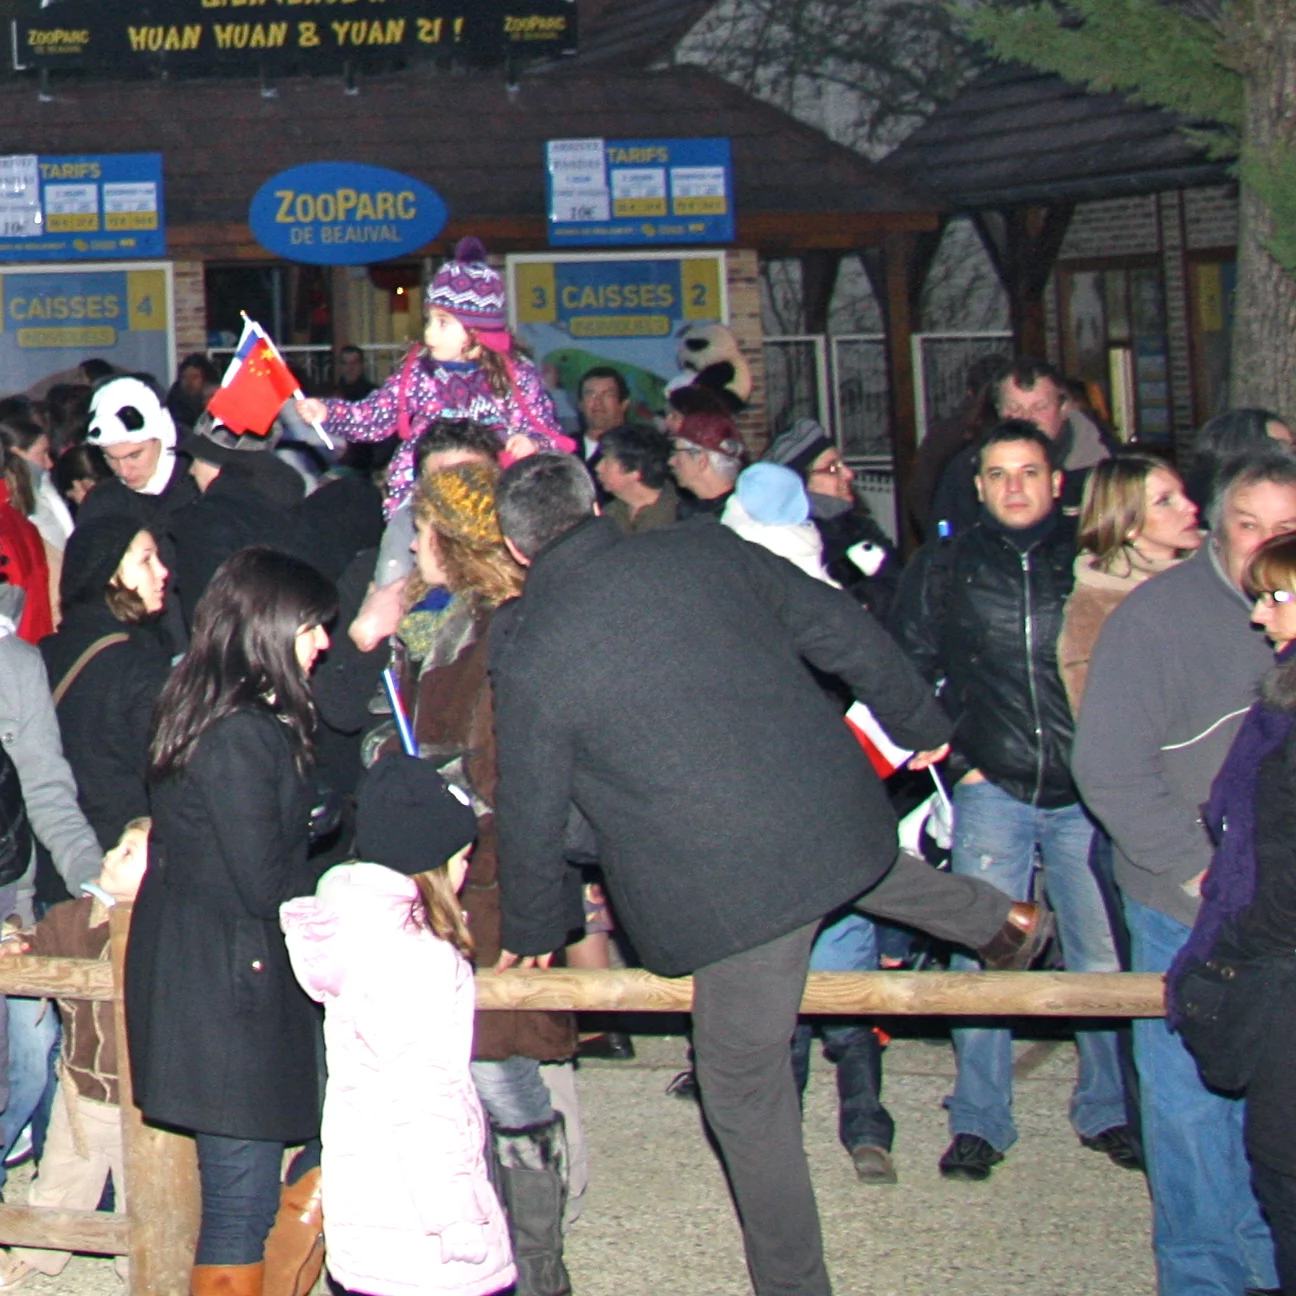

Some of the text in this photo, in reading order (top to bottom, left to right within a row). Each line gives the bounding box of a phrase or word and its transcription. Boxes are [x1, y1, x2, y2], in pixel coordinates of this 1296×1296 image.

[128, 24, 203, 51] HUAN
[214, 22, 288, 49] HUAN
[298, 22, 320, 47] &
[331, 17, 406, 46] YUAN
[608, 146, 668, 163] TARIFS
[40, 162, 101, 179] TARIFS
[290, 225, 402, 245] DE BEAUVAL
[9, 295, 121, 320] CAISSES
[137, 295, 153, 317] 4
[531, 284, 707, 309] 3 CAISSES 2
